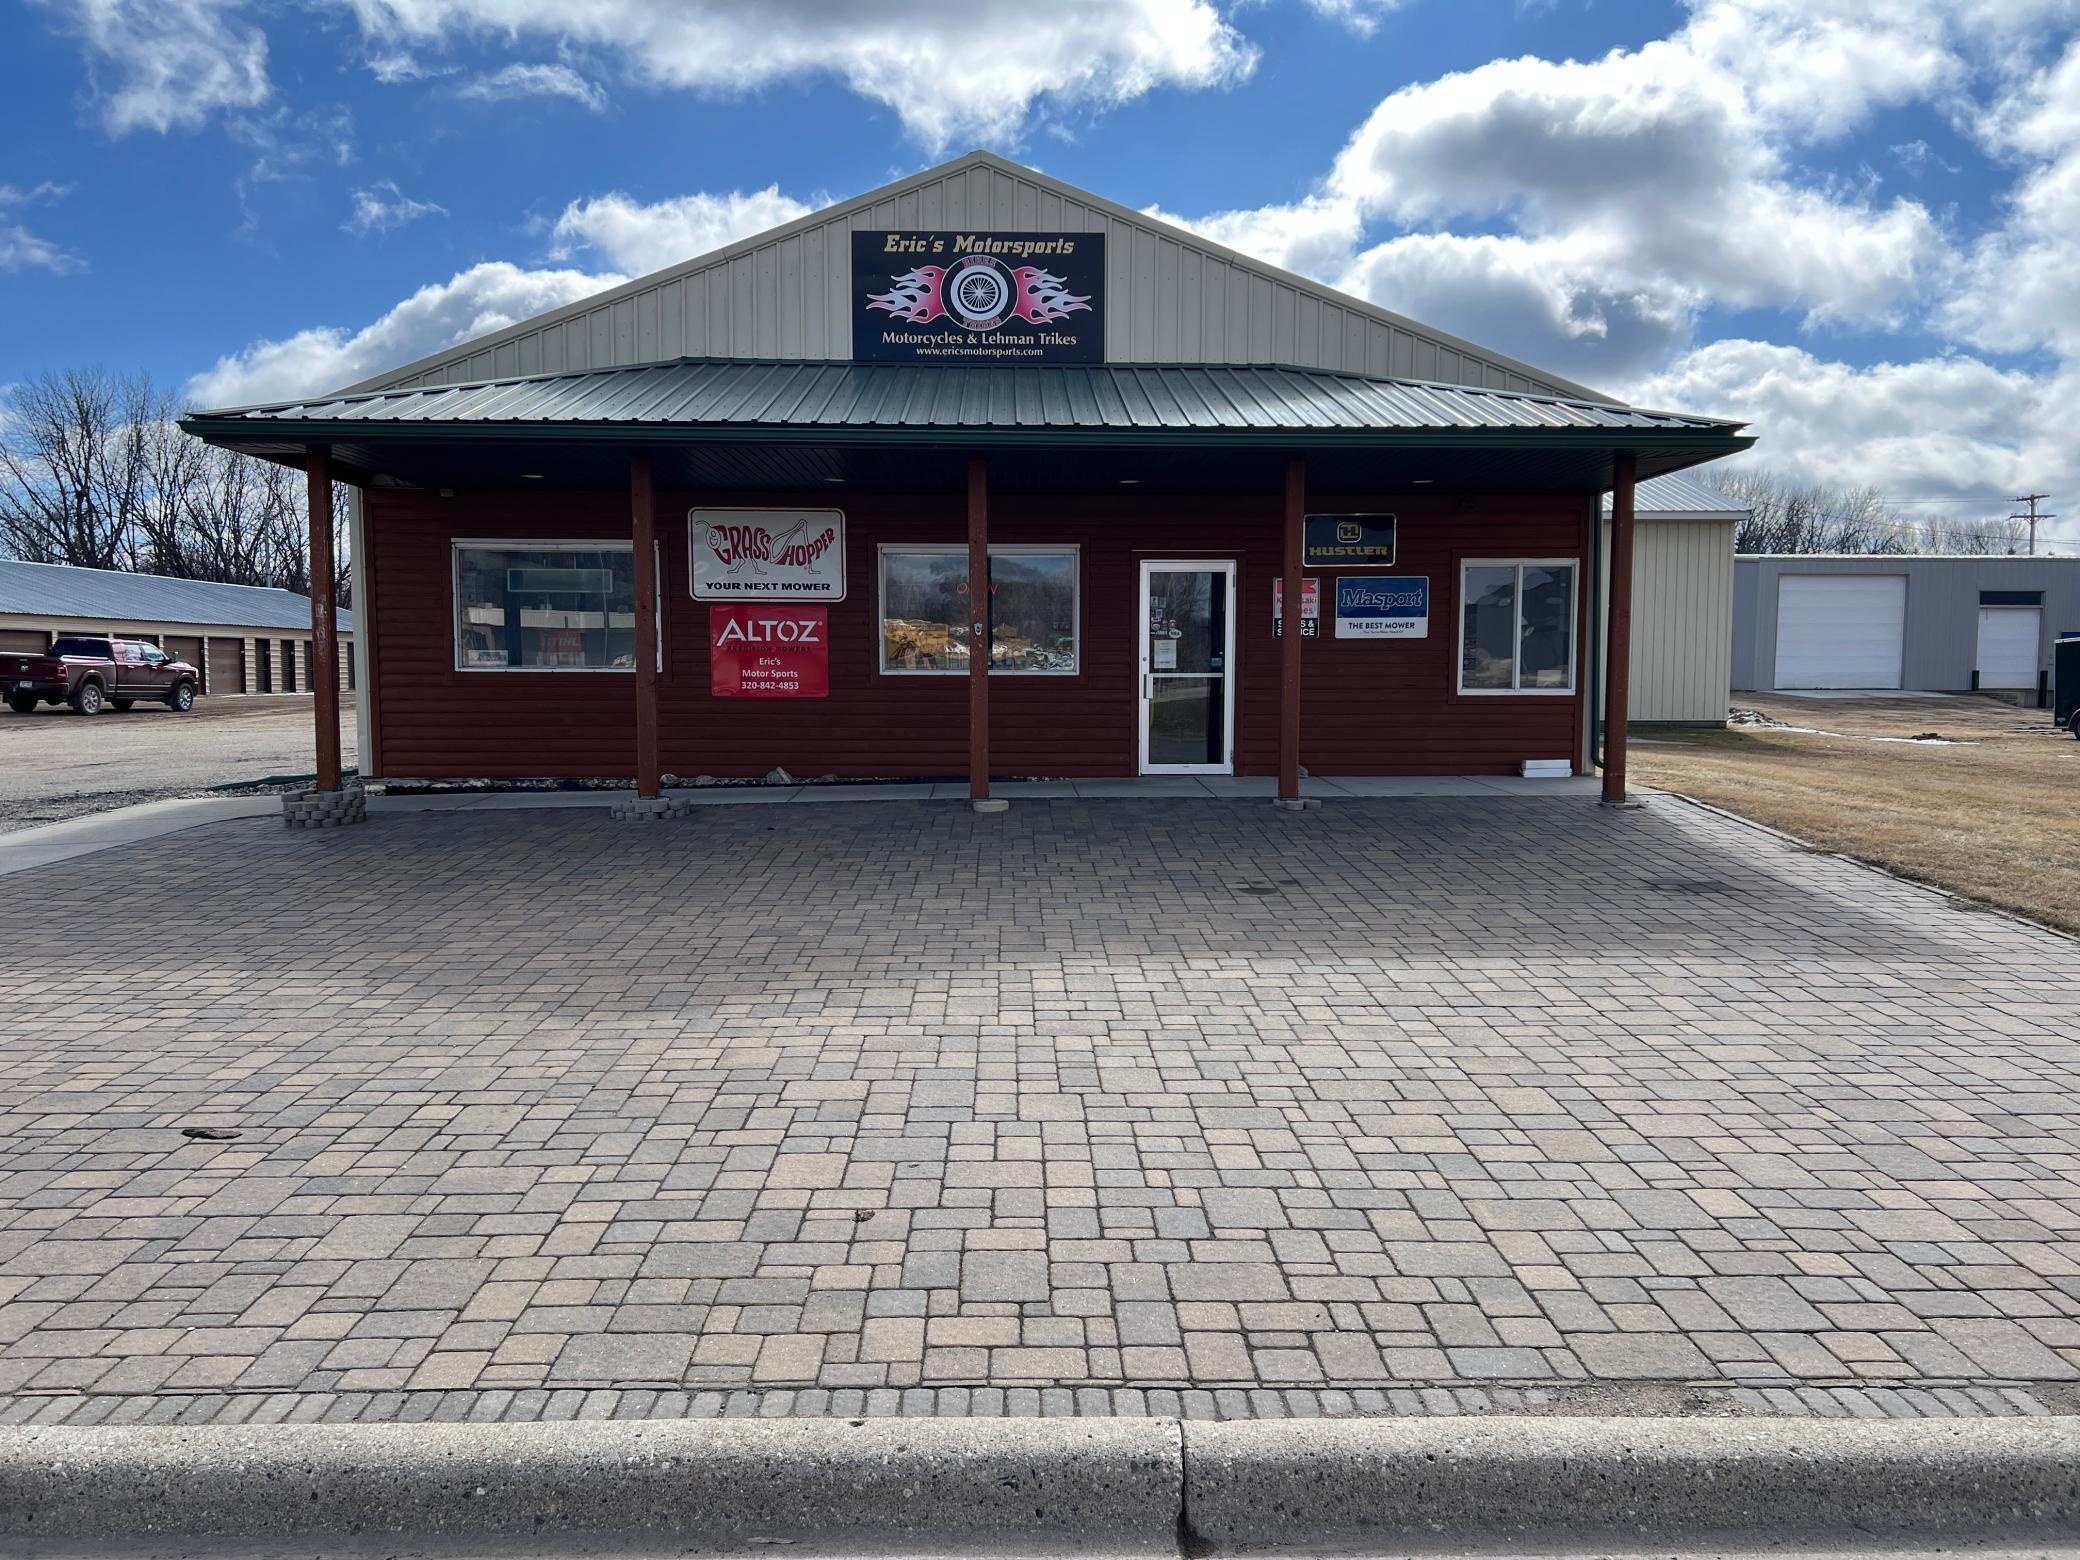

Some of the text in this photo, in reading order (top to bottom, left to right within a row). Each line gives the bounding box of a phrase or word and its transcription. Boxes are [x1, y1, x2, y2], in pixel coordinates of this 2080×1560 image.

[884, 234, 1075, 258] Eric's Motorsports
[882, 331, 1077, 347] Motorcycles & Lehman Trikes
[916, 347, 1043, 358] www.ericsmotorsports.com
[1309, 546, 1388, 556] HUSTLER
[706, 582, 831, 591] YOUR NEXT MOWER
[1340, 588, 1423, 610] Masport
[716, 618, 820, 647] ALTOZ
[1277, 628, 1315, 636] SICE
[771, 669, 798, 678] Sports
[741, 682, 799, 690] 320-842-4853
